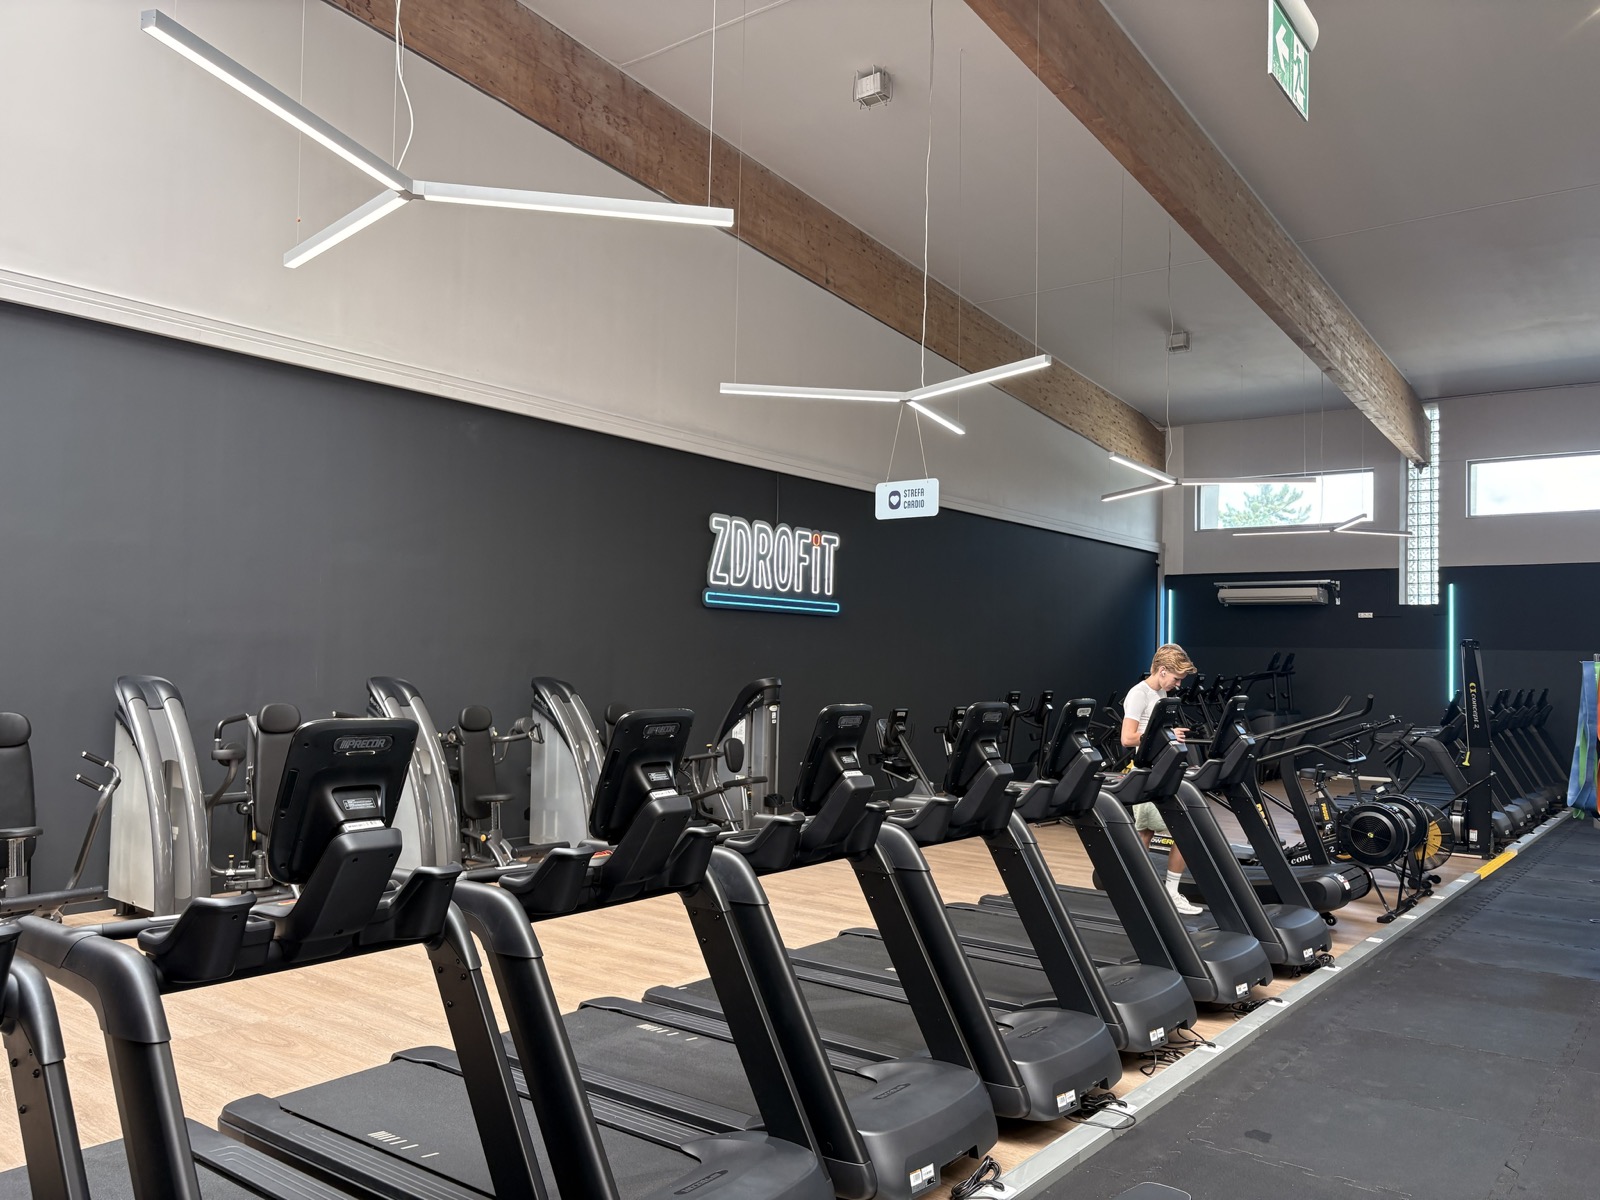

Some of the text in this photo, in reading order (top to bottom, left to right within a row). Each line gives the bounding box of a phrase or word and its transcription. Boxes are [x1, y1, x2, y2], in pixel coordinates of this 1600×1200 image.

[903, 488, 925, 498] STREFA
[903, 499, 925, 509] CARDIO
[341, 738, 386, 749] PRECOR
